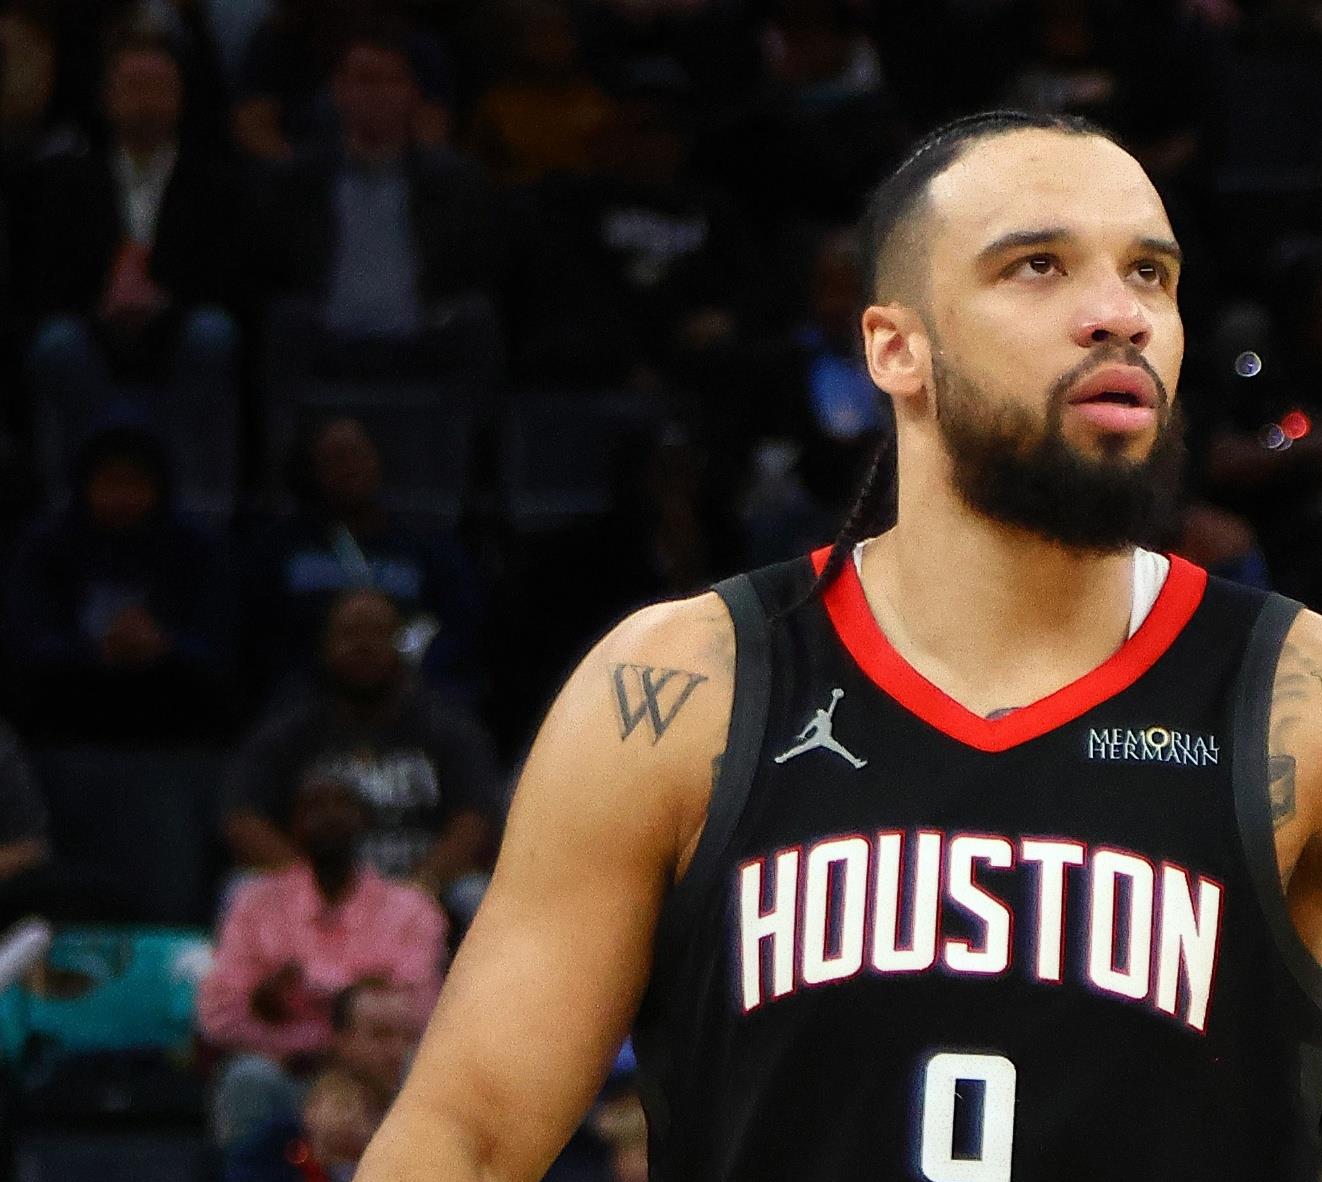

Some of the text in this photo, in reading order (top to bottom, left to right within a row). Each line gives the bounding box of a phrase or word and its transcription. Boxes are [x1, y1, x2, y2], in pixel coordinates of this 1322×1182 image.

[612, 663, 709, 748] W
[1088, 726, 1221, 752] MEMORIAL
[1088, 740, 1220, 767] HERMANN
[736, 828, 1226, 1035] HOUSTON
